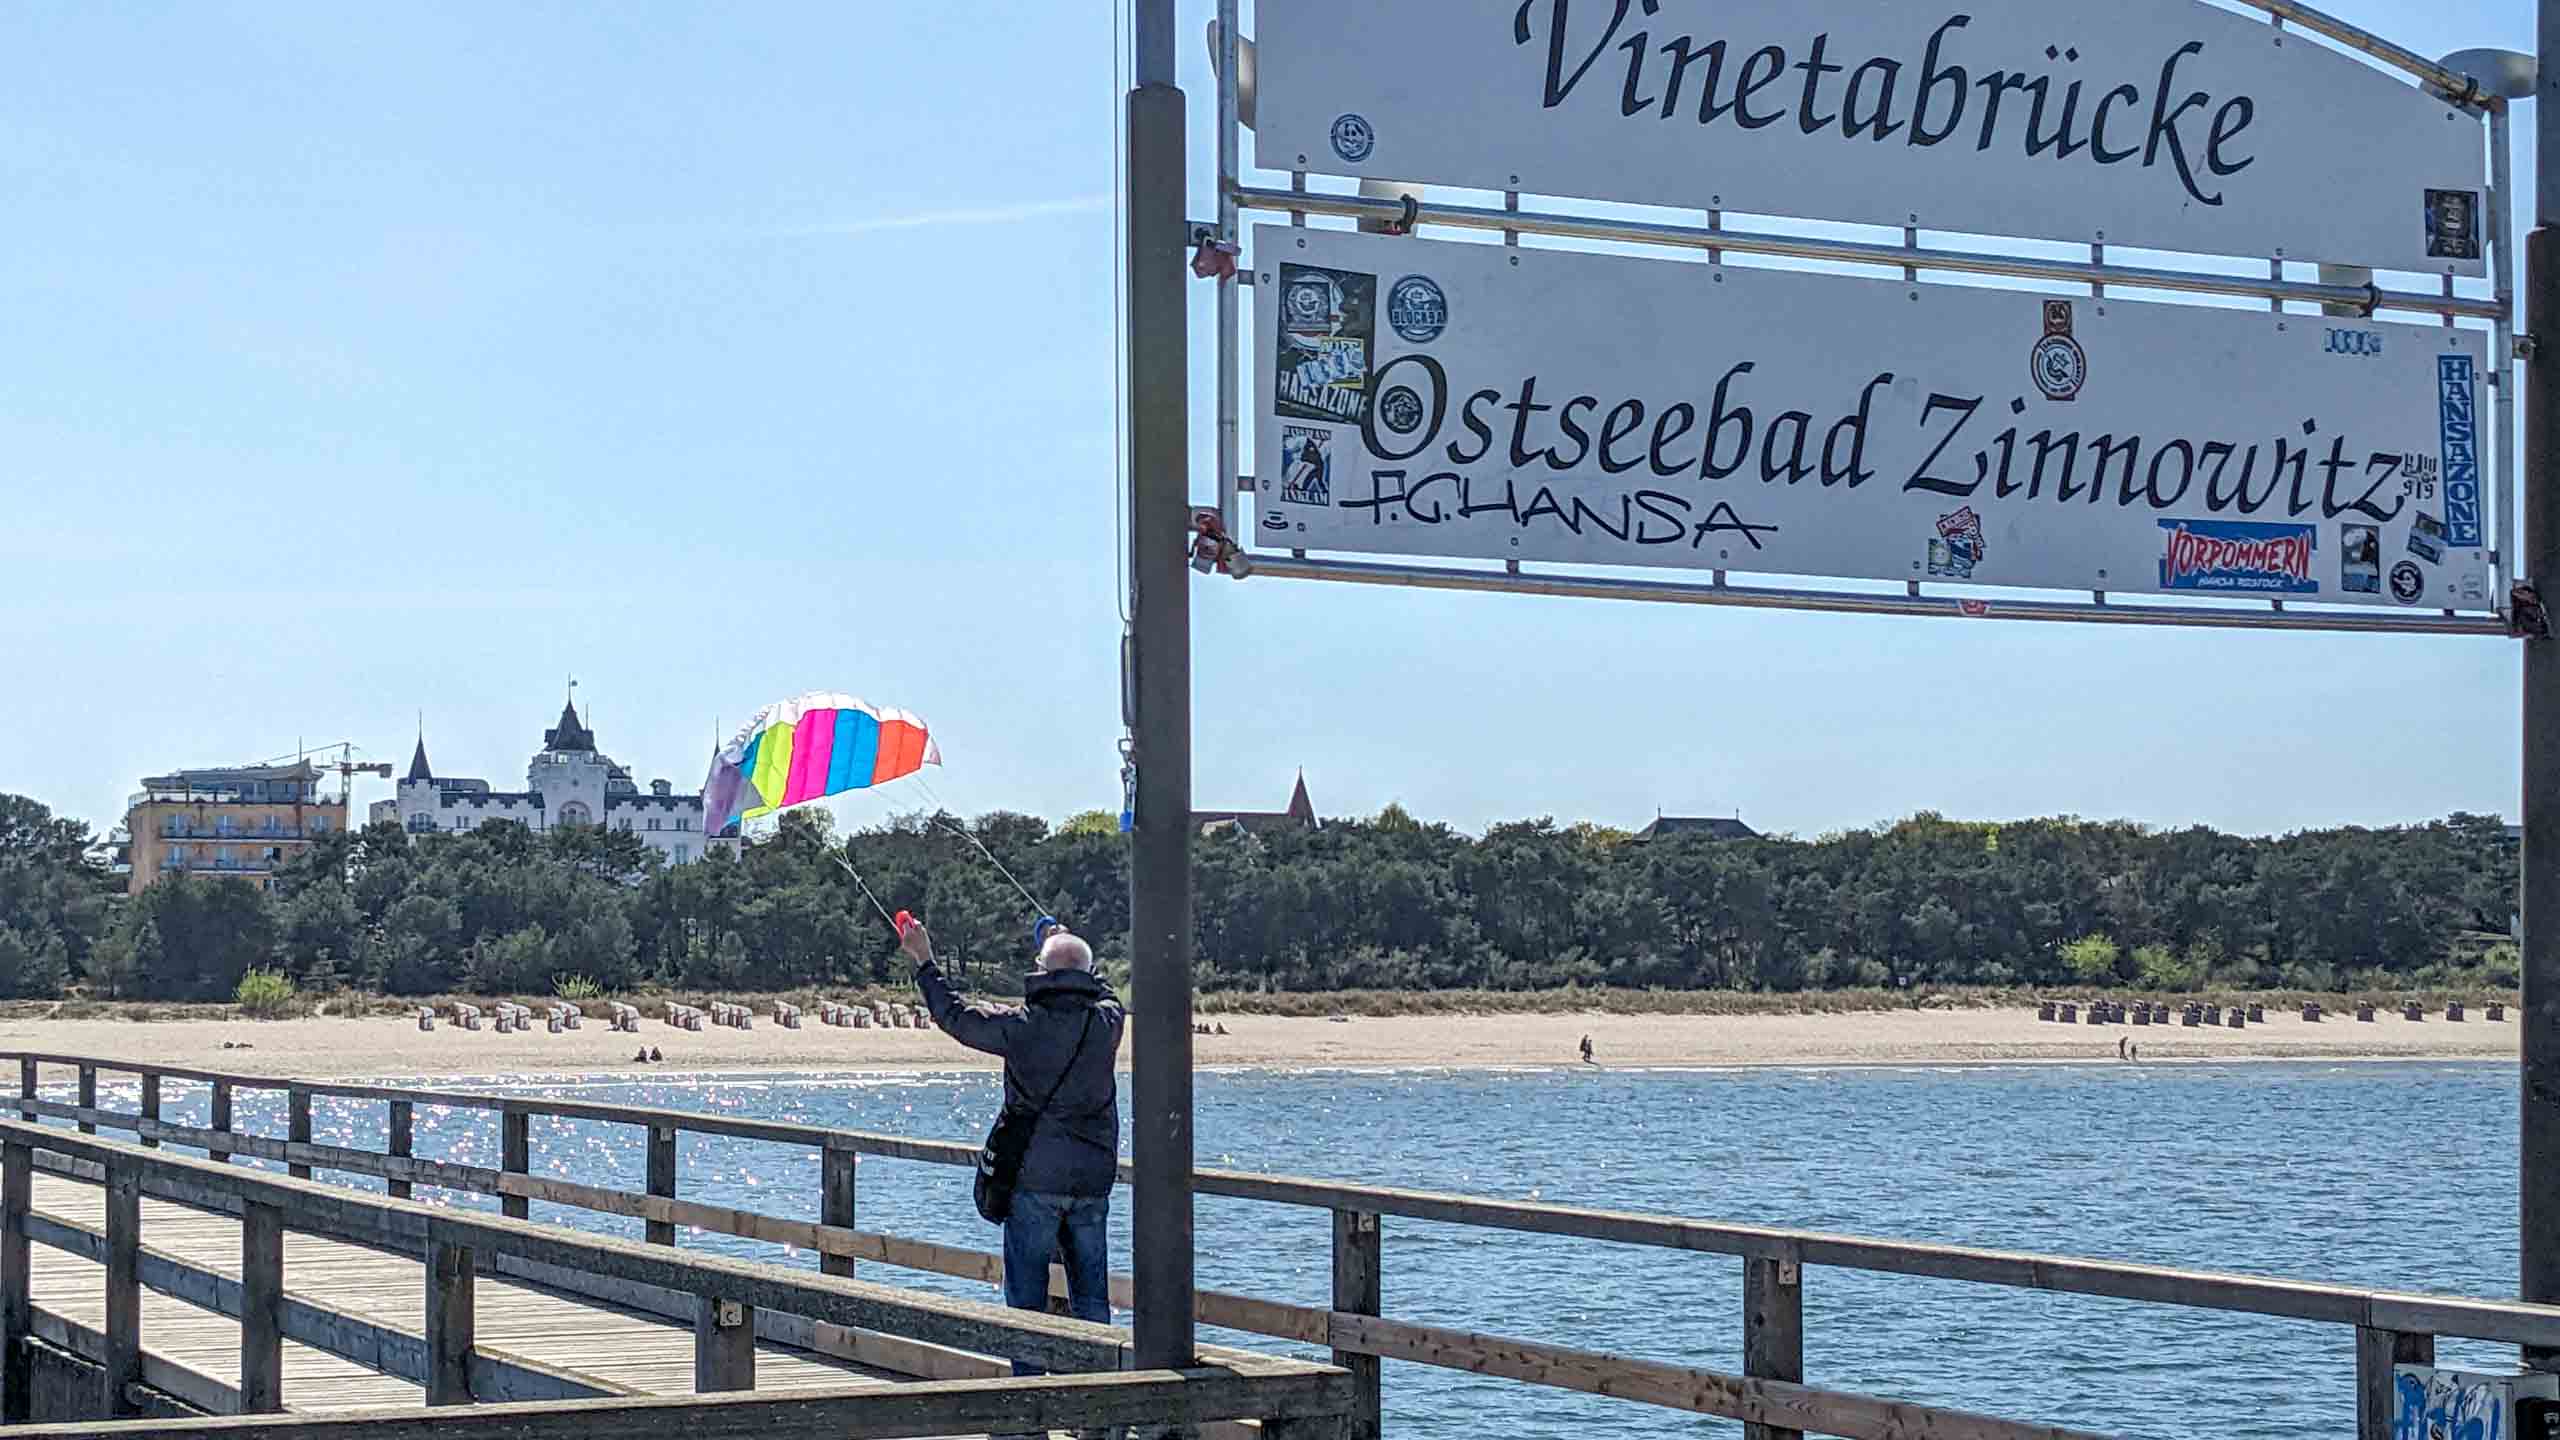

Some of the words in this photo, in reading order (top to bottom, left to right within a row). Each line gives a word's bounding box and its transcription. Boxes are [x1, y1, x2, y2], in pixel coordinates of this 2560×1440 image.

[1514, 0, 2254, 207] Vinetabrücke
[1360, 353, 1895, 489] Ostseebad
[1903, 393, 2404, 522] Zinnowitz
[2442, 360, 2477, 541] HANSAZONE
[2167, 525, 2312, 583] VORPOMMERN
